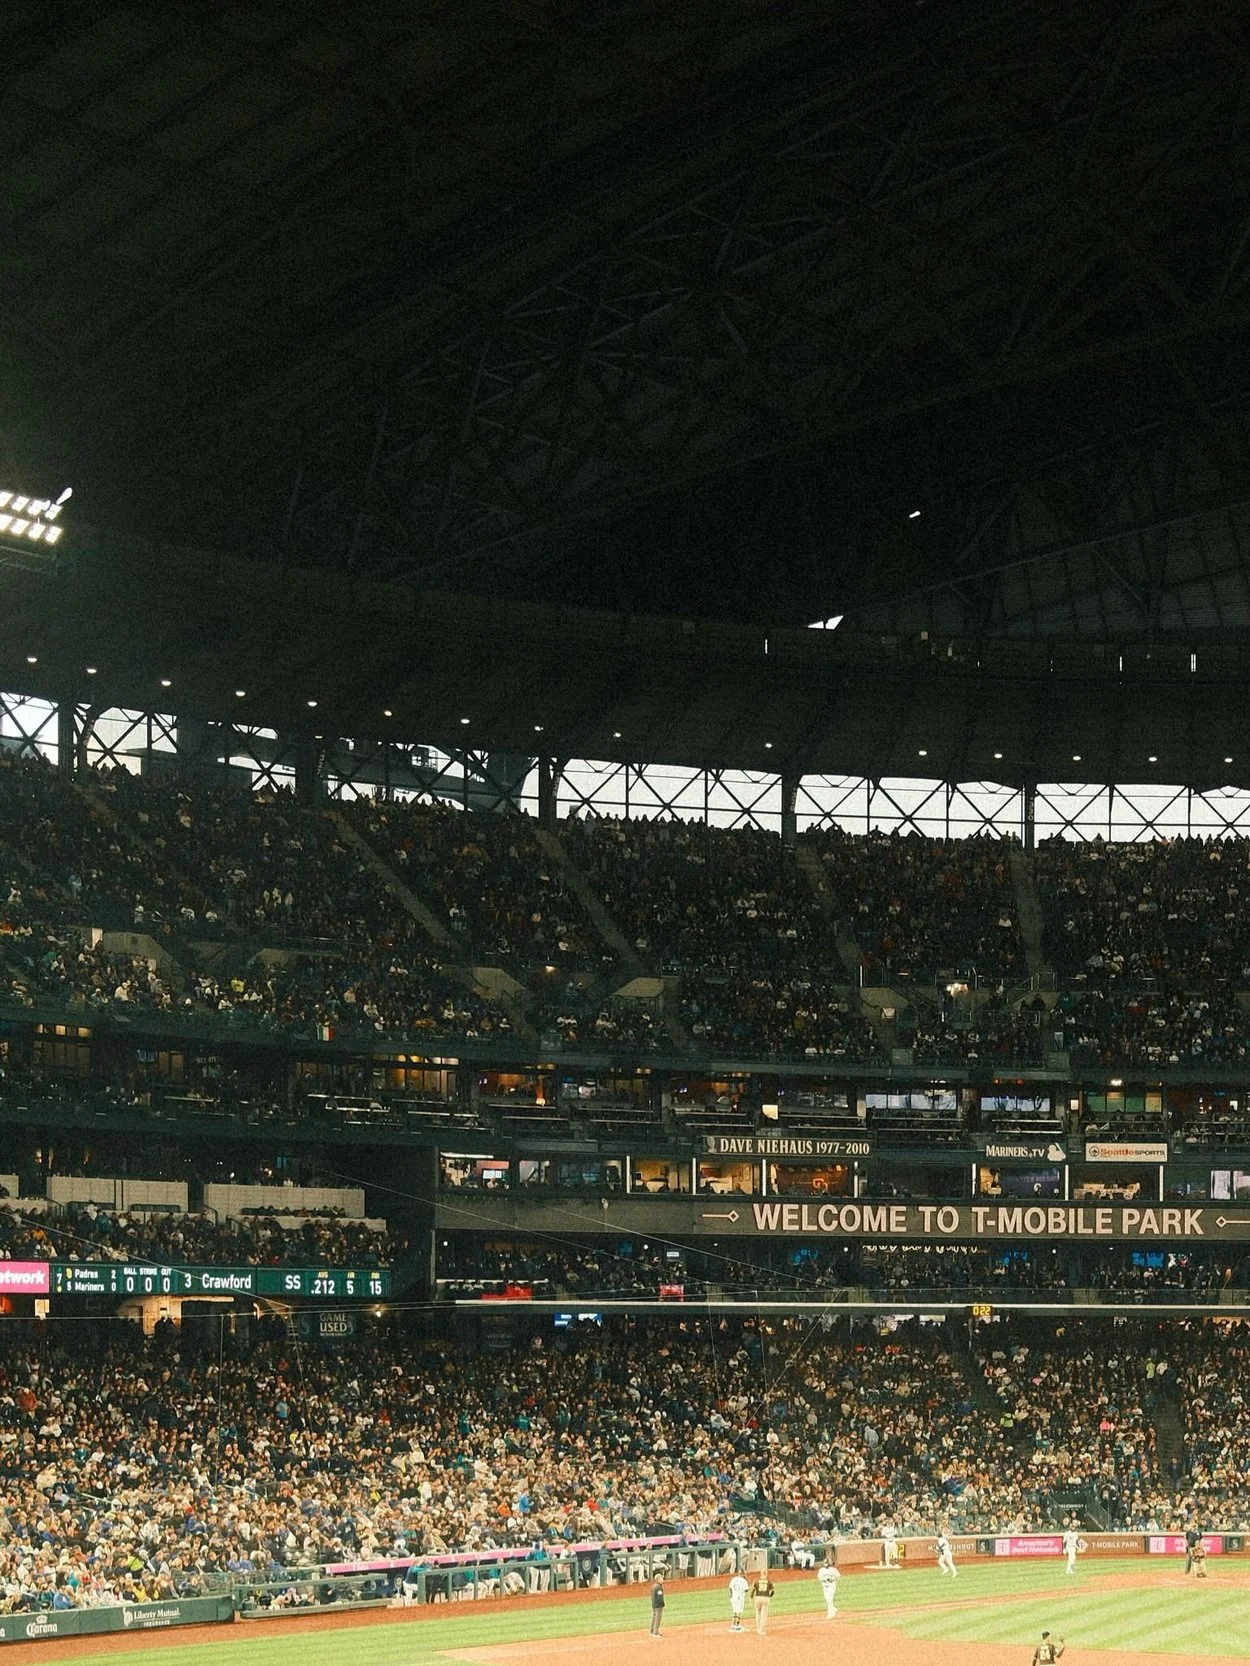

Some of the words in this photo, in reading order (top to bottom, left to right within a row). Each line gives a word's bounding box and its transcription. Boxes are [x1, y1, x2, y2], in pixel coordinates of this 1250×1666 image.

[720, 1138, 753, 1153] DAVE
[757, 1139, 813, 1154] NIEHAUS
[816, 1141, 870, 1155] 1977-2010
[752, 1203, 907, 1232] WELCOME
[919, 1206, 959, 1233] TO
[972, 1207, 1113, 1235] T-MOBILE
[1121, 1208, 1204, 1235] PARK
[57, 1273, 62, 1284] 7
[74, 1269, 99, 1279] Padres
[111, 1270, 116, 1279] 2
[184, 1273, 192, 1289] 3
[202, 1274, 251, 1289] Crawford
[74, 1282, 105, 1292] Mariners
[111, 1282, 116, 1292] 0
[126, 1277, 134, 1292] 0
[145, 1277, 152, 1292] 0
[163, 1277, 170, 1292] 0
[285, 1275, 301, 1290] SS
[310, 1280, 335, 1294] .212
[347, 1281, 354, 1294] 5
[369, 1281, 381, 1294] 15
[320, 1313, 347, 1322] GAME
[320, 1322, 347, 1332] USED
[134, 1609, 156, 1620] Liberty
[26, 1622, 58, 1638] Corona
